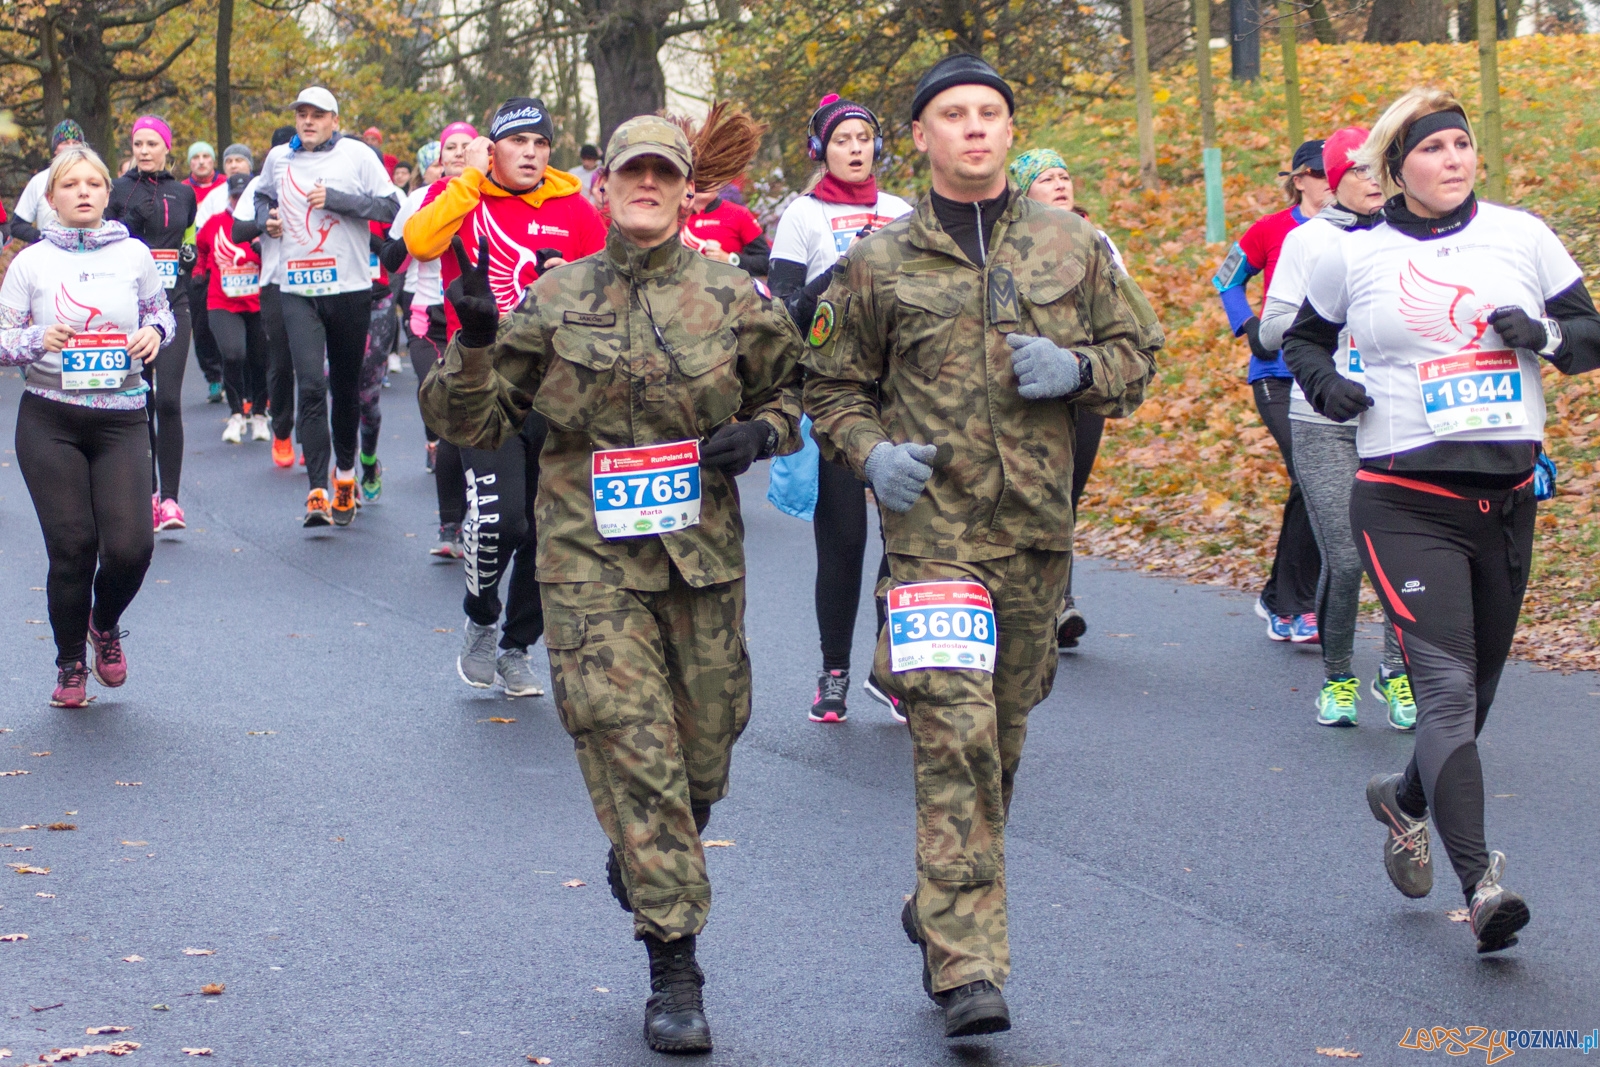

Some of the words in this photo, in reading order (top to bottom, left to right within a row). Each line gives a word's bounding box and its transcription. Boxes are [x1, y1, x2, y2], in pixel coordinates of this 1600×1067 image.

[226, 275, 255, 287] 5027
[294, 269, 333, 284] 6166
[71, 351, 126, 370] 3769
[1425, 393, 1434, 403] E
[1437, 375, 1514, 406] 1944
[650, 452, 693, 464] RunPoland.org
[596, 489, 604, 499] E
[607, 472, 691, 507] 3765
[475, 473, 500, 590] PARENTAL
[952, 592, 989, 604] RunPoland.org
[894, 624, 902, 634] E
[906, 611, 989, 640] 3608
[898, 660, 919, 668] LUXMED
